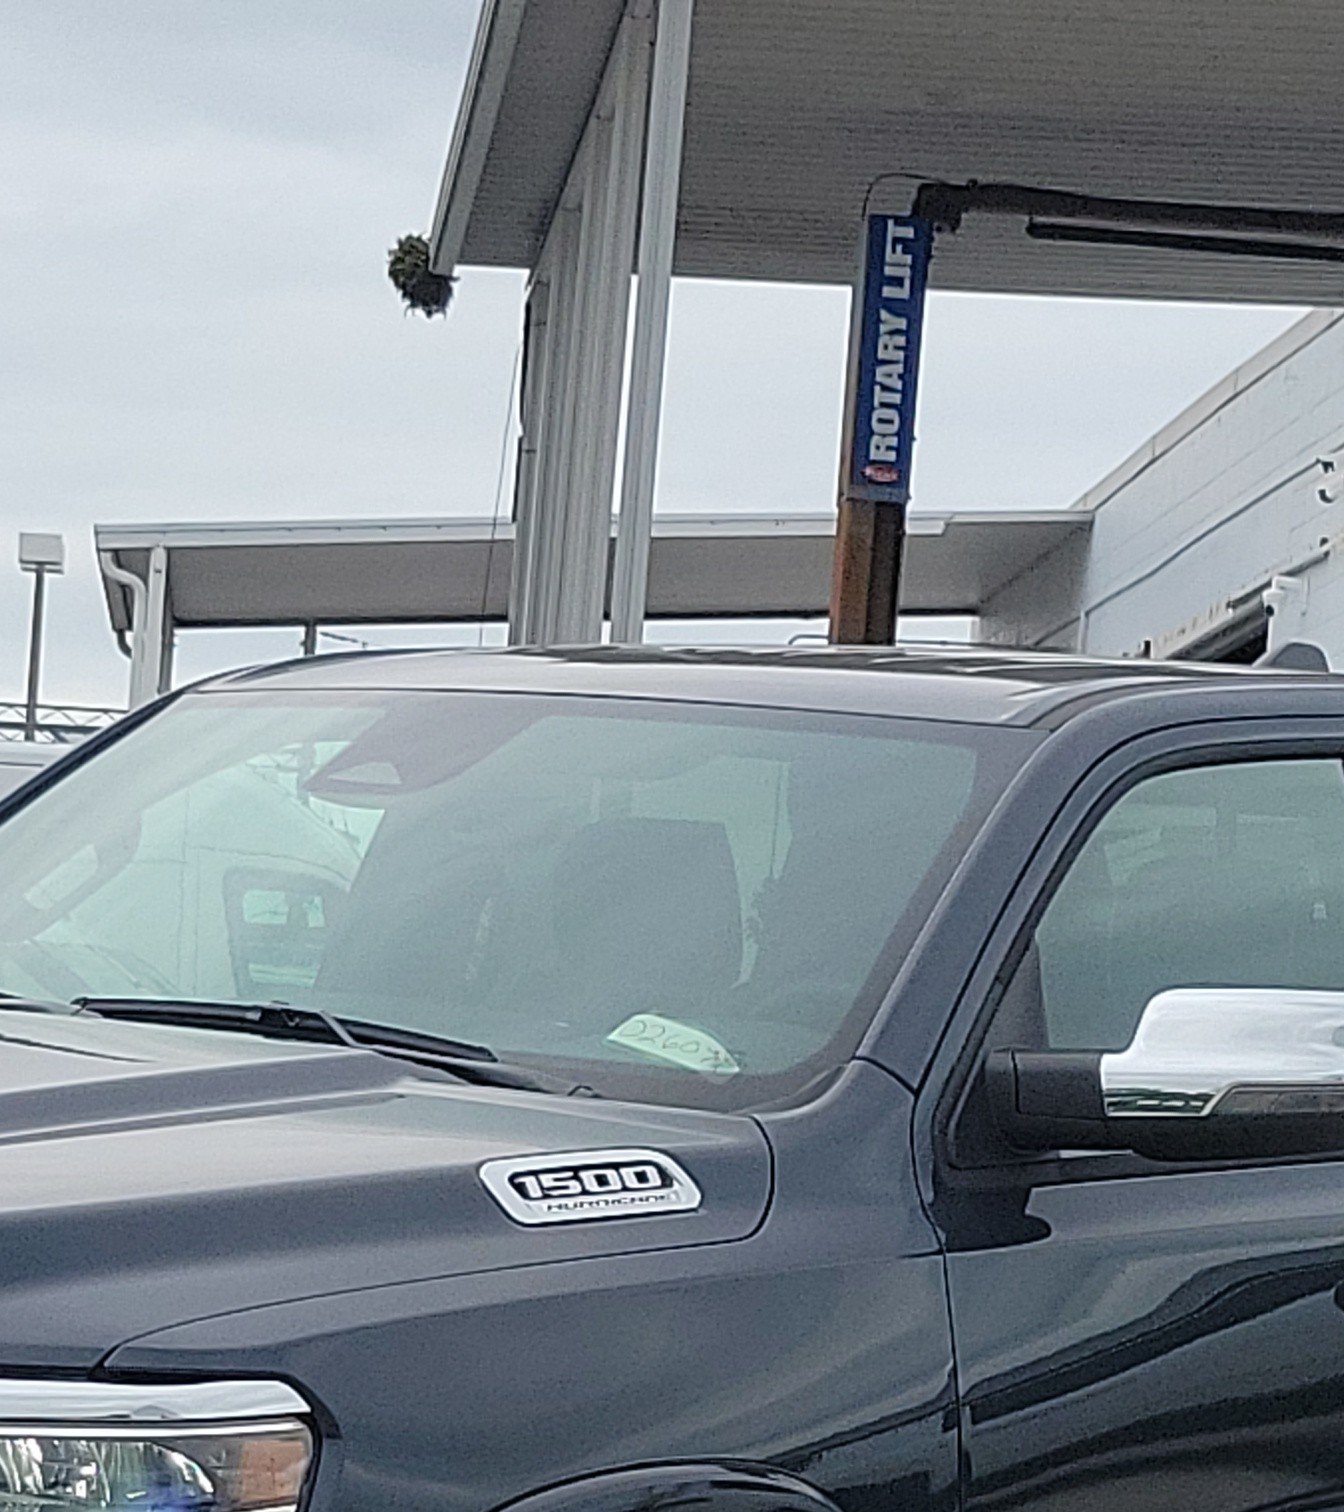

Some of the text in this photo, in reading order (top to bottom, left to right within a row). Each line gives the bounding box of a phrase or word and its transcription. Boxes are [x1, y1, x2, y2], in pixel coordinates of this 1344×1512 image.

[869, 218, 916, 463] ROTARY LIFT
[514, 1165, 662, 1199] 1500
